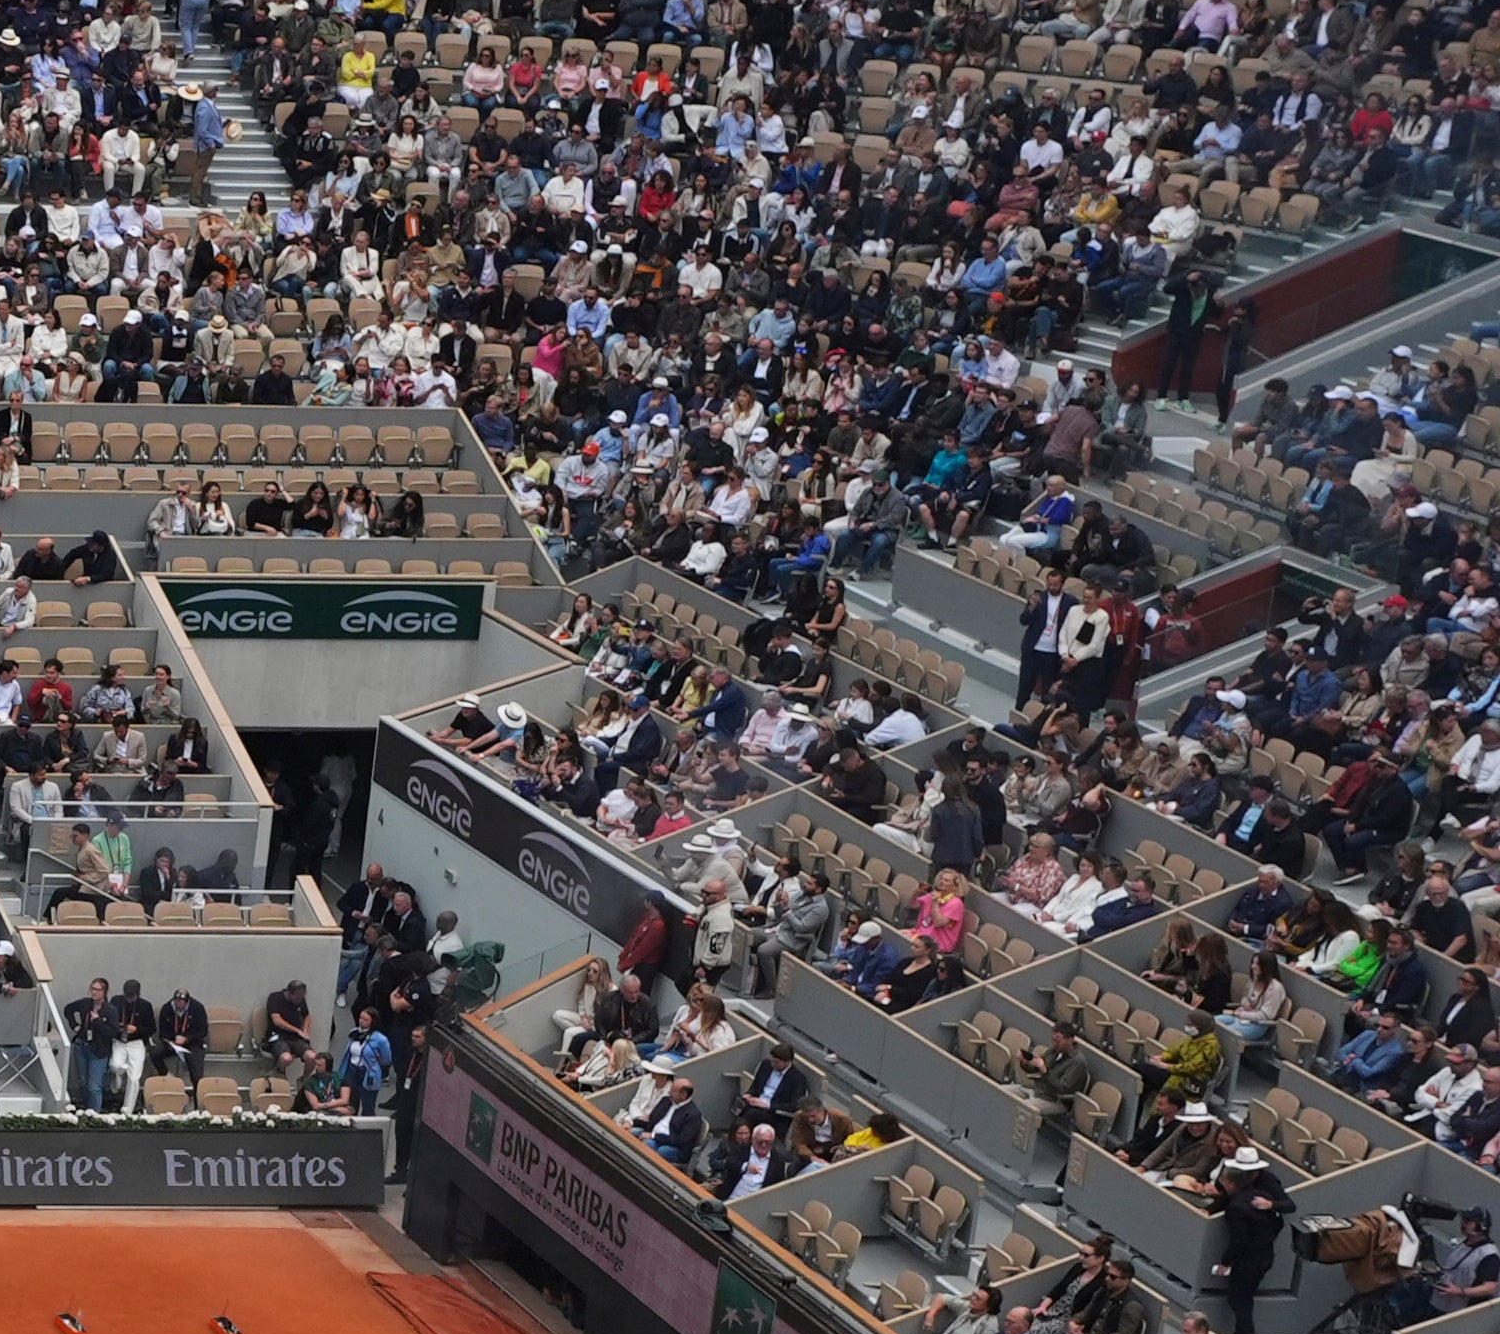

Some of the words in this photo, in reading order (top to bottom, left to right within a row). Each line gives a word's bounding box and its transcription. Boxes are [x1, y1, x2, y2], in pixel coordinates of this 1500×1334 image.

[164, 1149, 346, 1190] Emirates
[500, 1120, 541, 1175] BNP
[544, 1154, 628, 1249] PARIBAS
